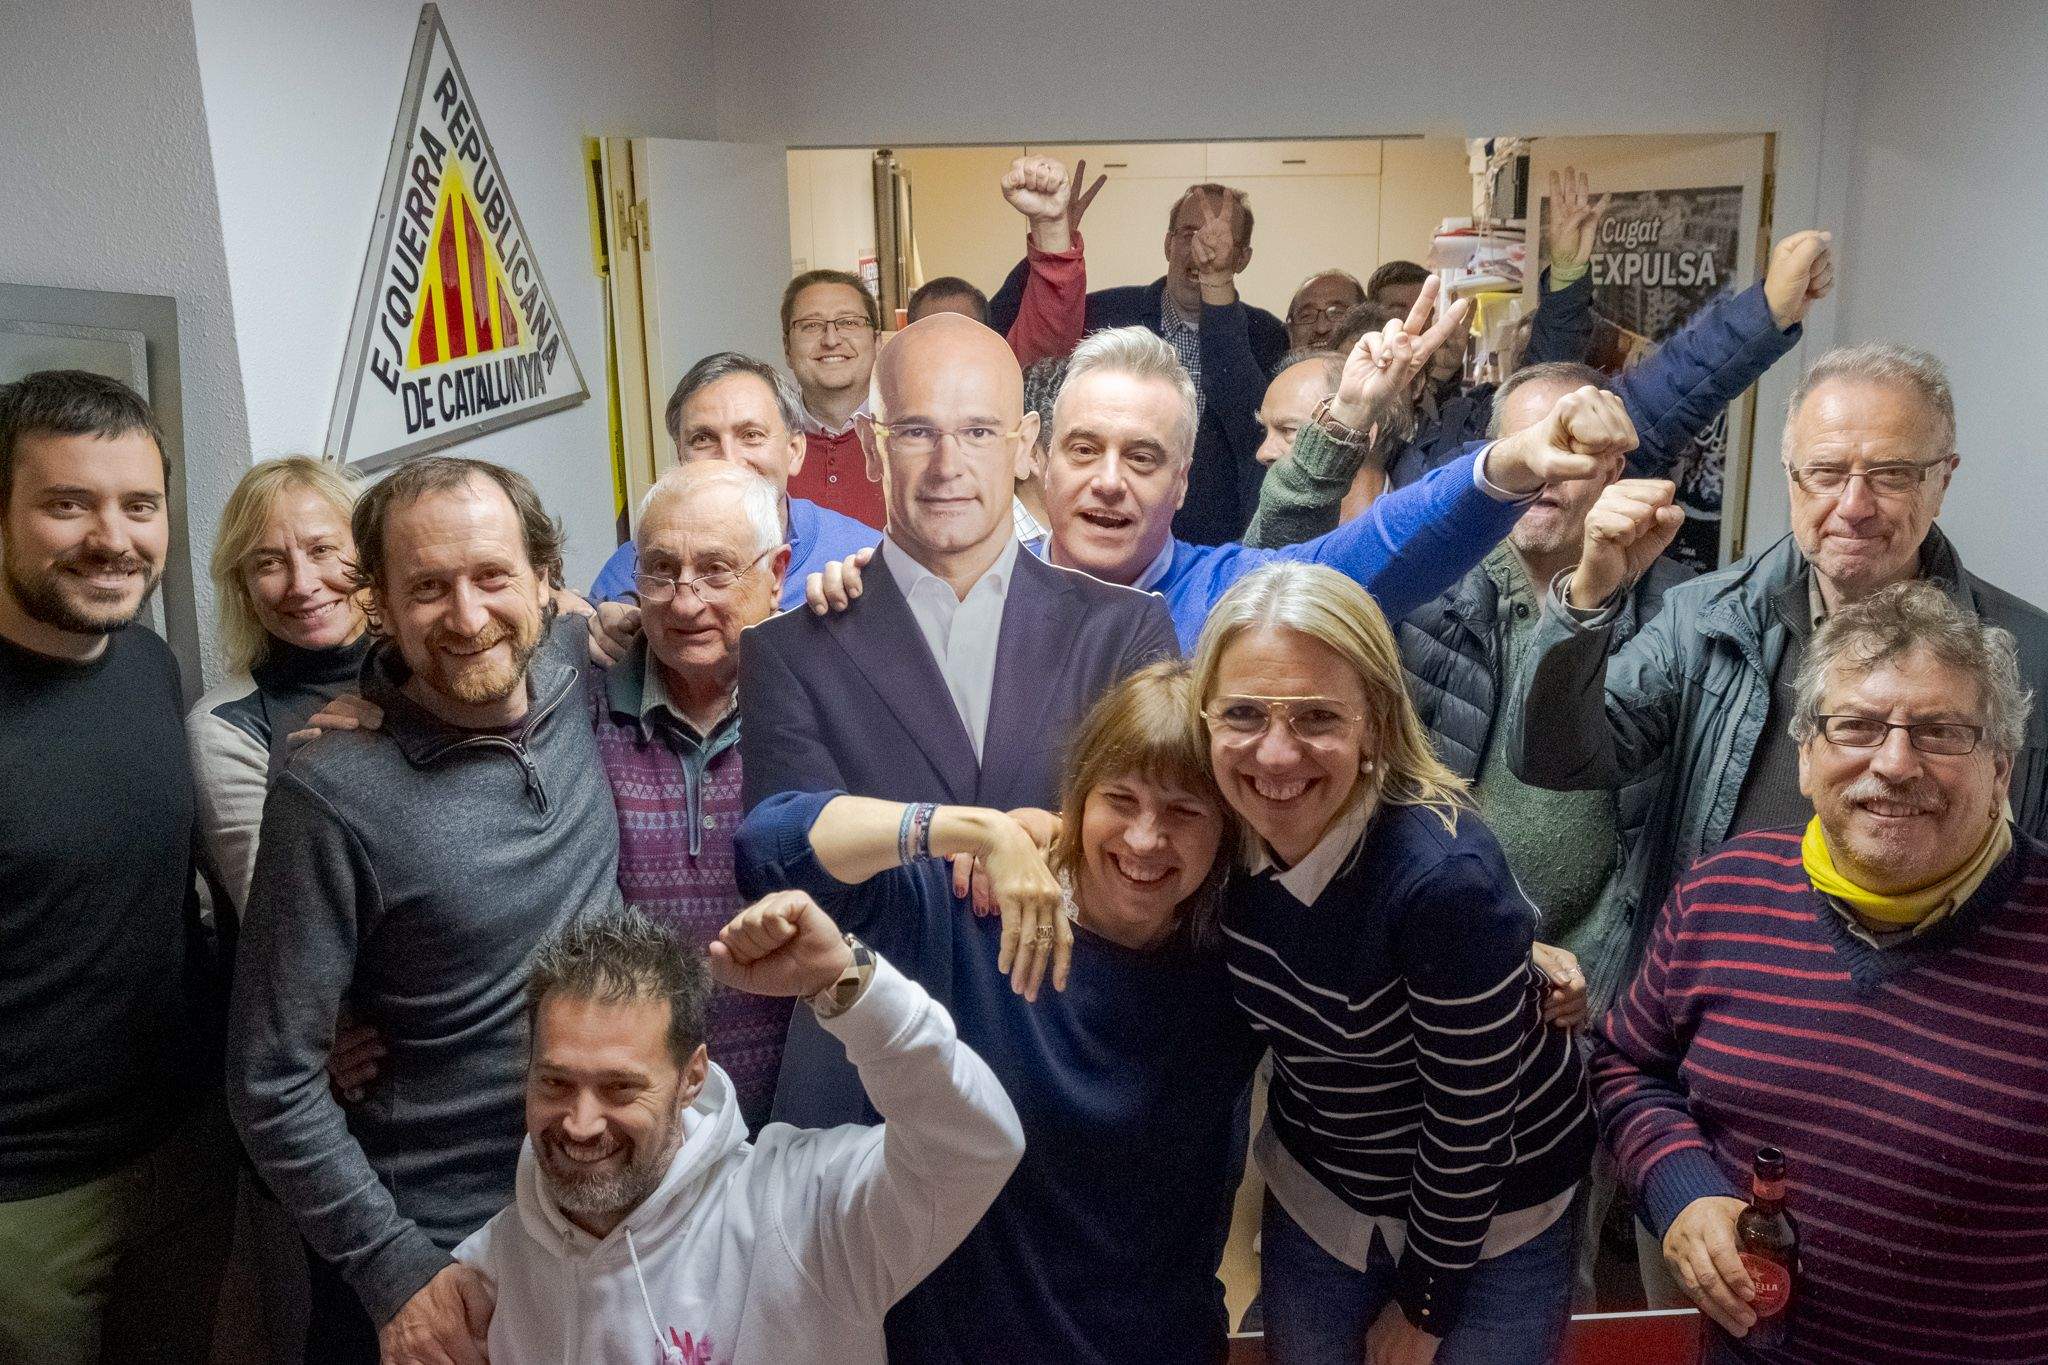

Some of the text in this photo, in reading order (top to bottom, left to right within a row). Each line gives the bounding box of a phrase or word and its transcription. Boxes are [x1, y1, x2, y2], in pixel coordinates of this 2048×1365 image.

[433, 67, 559, 375] REPUBLICANA
[1602, 216, 1662, 249] Cugat
[371, 126, 446, 395] ESQUERRA
[1590, 252, 1717, 286] EXPULSA
[401, 351, 547, 434] DE CATALUNYA
[1755, 1281, 1778, 1292] ELLA
